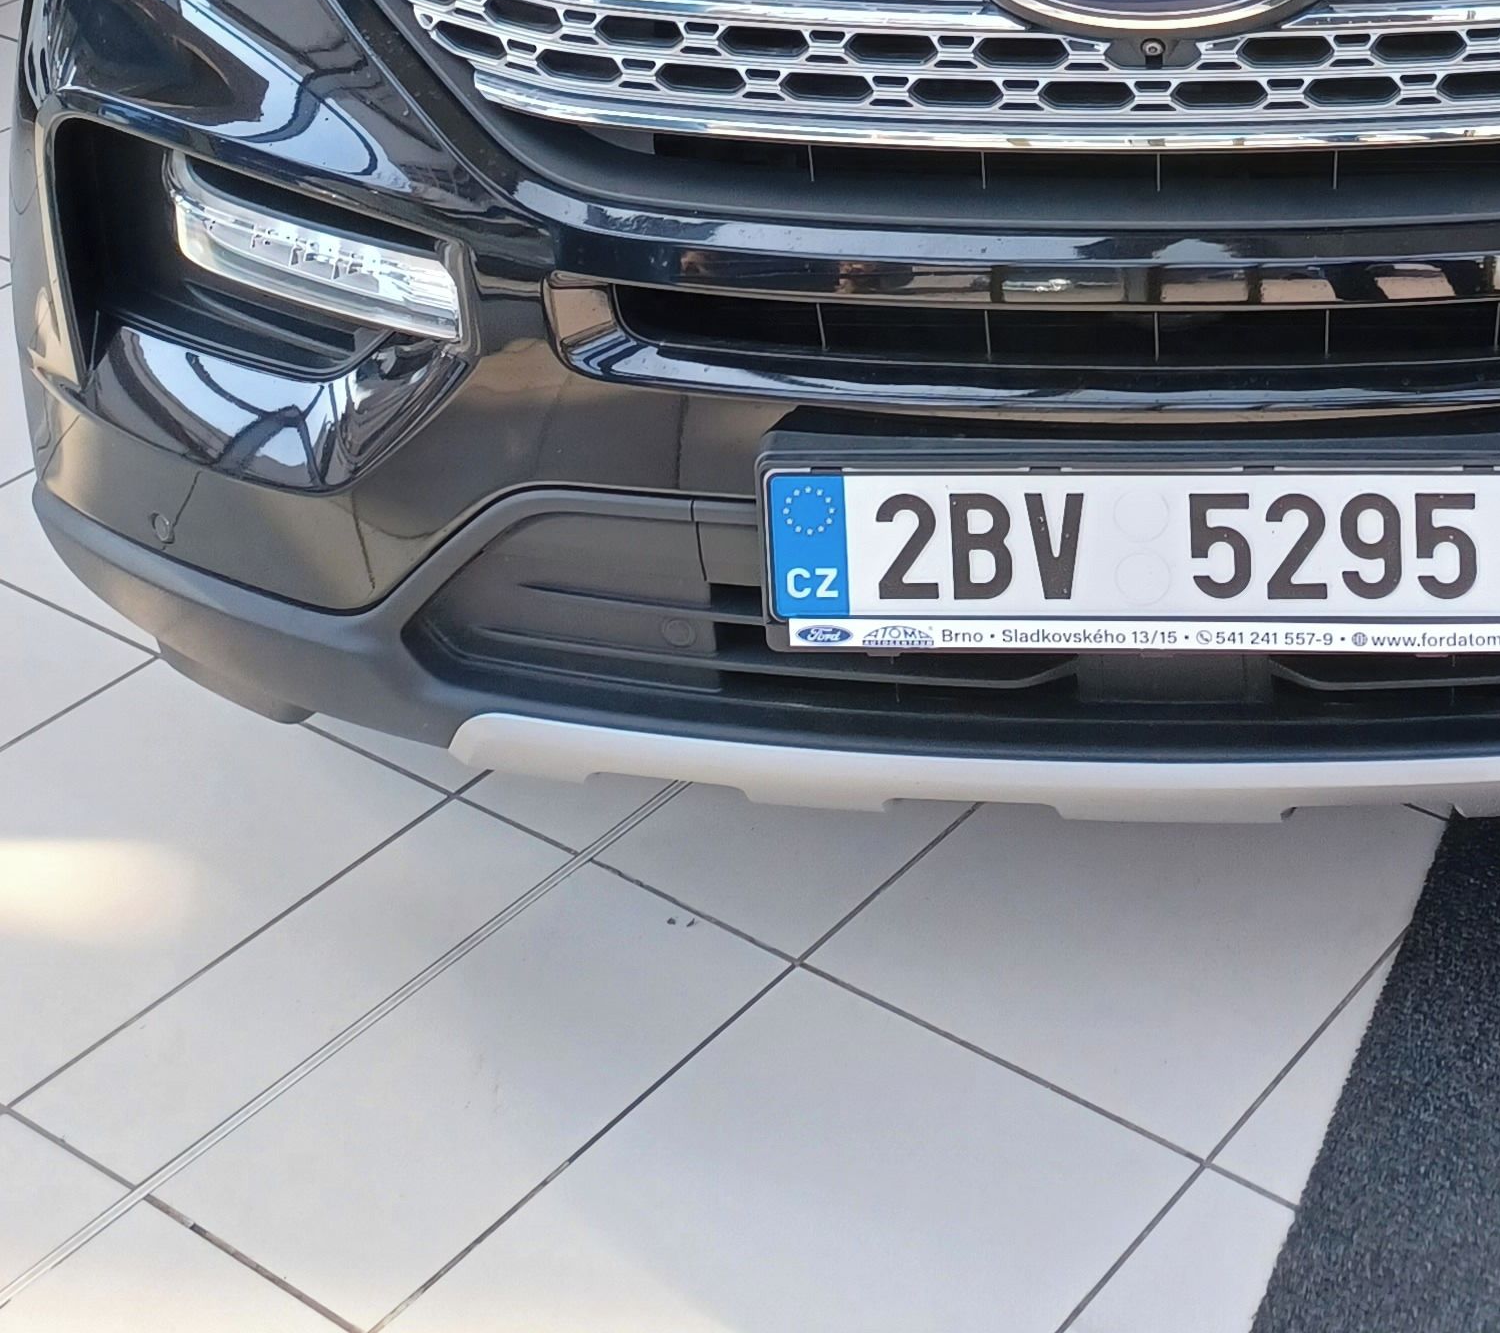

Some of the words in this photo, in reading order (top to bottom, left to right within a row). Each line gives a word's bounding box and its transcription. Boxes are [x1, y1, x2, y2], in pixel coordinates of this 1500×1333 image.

[875, 492, 1084, 600] 2BV
[1188, 492, 1477, 600] 5295
[786, 567, 839, 598] CZ
[807, 626, 841, 641] Ford
[942, 628, 983, 642] Brno
[1002, 629, 1126, 644] Sladkovského
[1132, 631, 1177, 644] 13/15
[1215, 631, 1244, 645] 541
[1250, 632, 1278, 645] 241
[1285, 632, 1333, 646] 557-9
